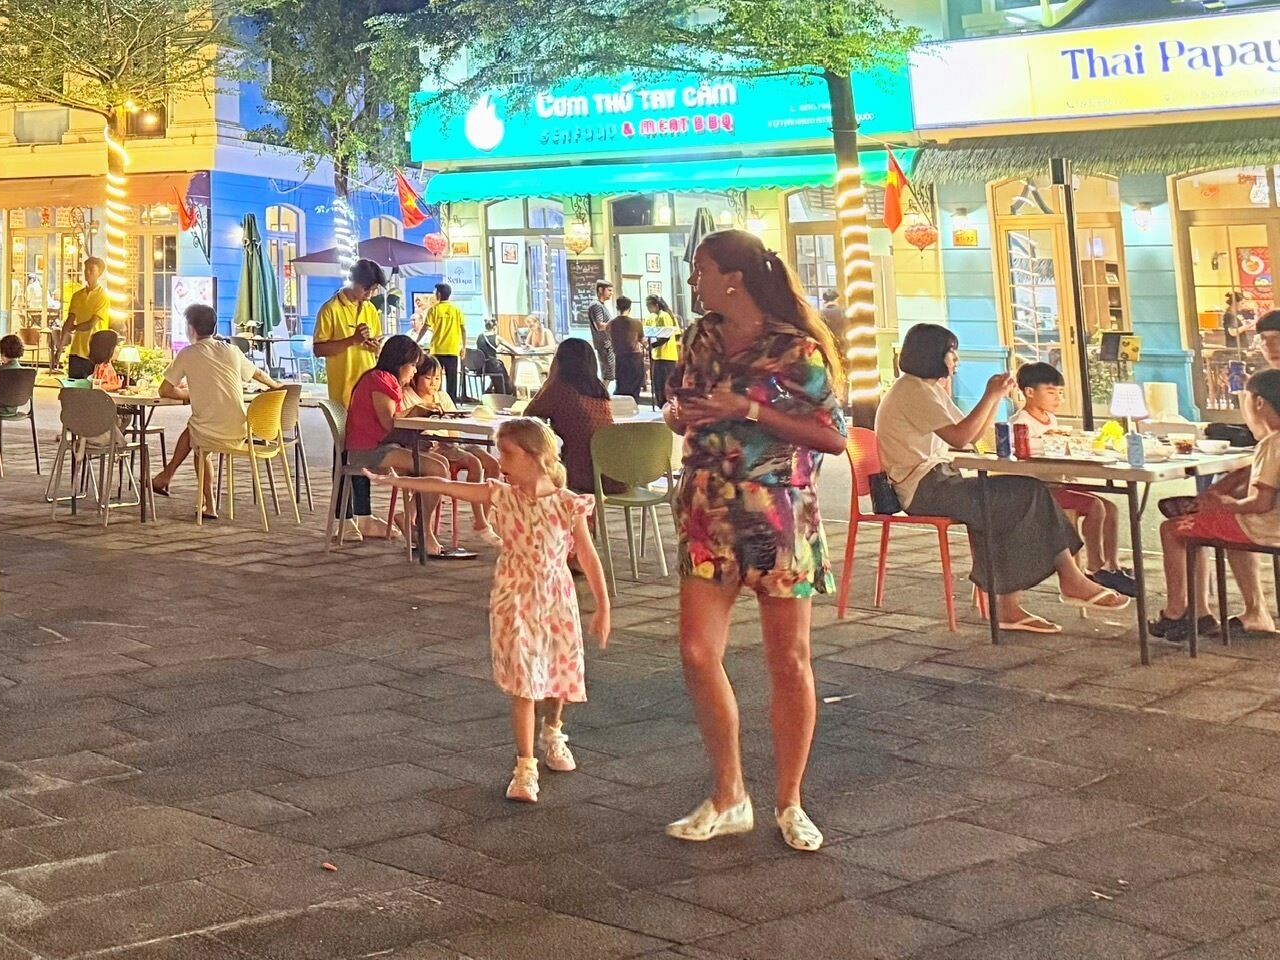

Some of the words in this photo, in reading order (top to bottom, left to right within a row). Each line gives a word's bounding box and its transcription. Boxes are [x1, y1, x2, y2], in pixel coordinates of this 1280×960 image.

[1061, 44, 1145, 80] Thai
[637, 88, 676, 112] TAY
[622, 121, 635, 137] &
[640, 117, 689, 138] MEAT
[694, 113, 736, 135] BBQ
